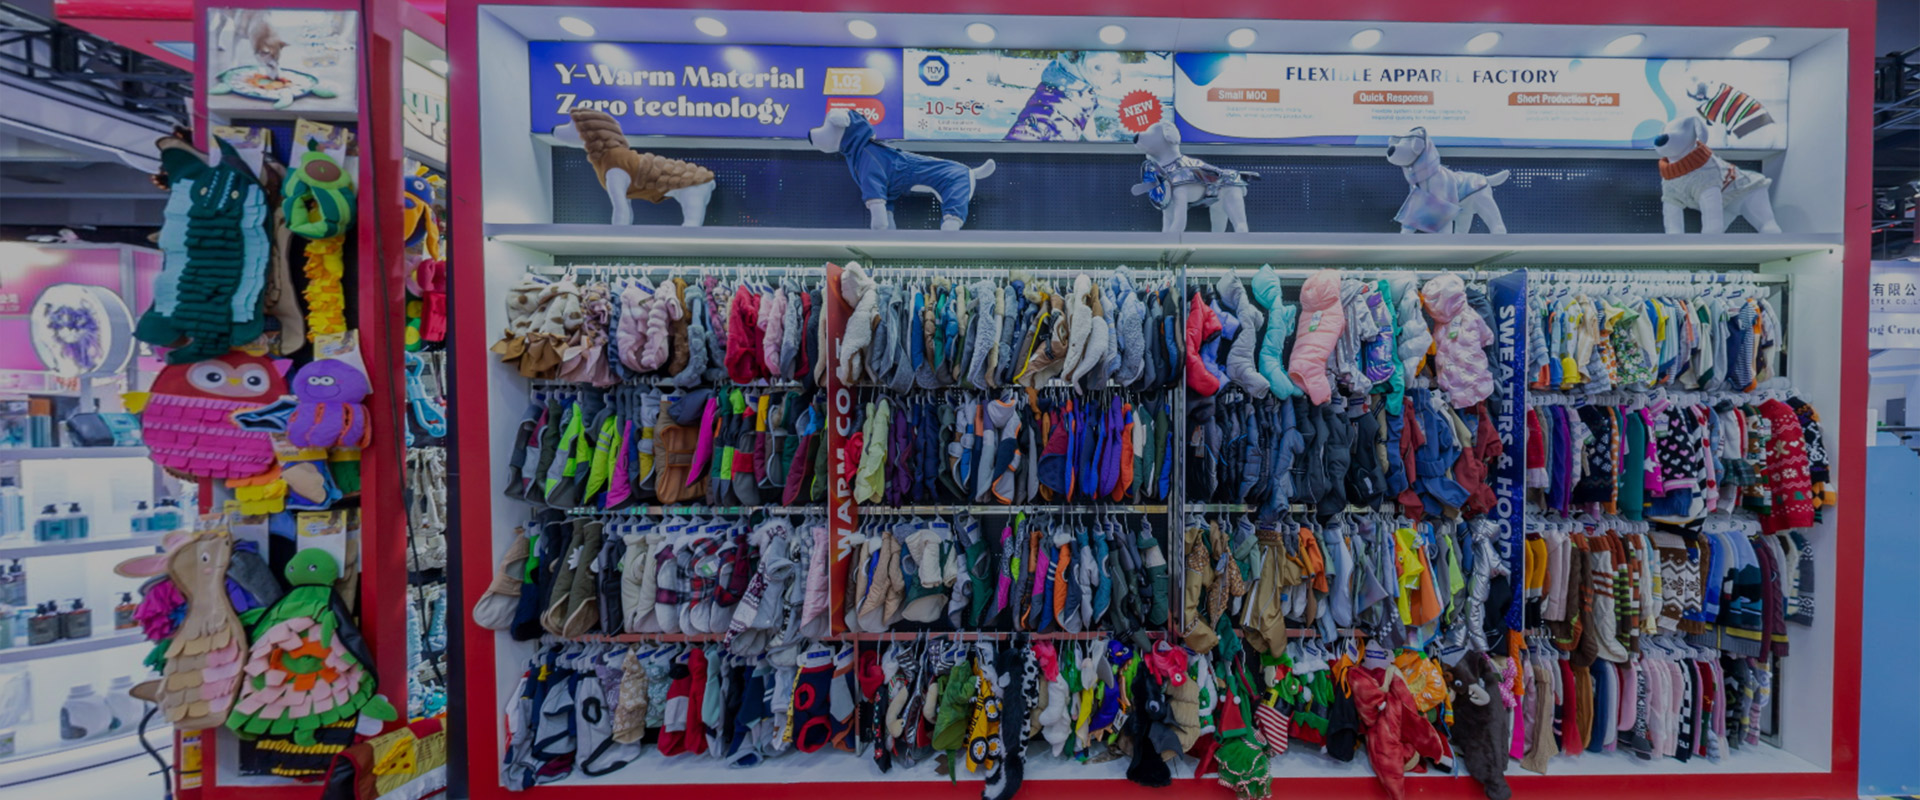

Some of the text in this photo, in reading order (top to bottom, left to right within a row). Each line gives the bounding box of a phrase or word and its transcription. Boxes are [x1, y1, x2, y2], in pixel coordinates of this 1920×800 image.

[554, 63, 805, 89] Y-Warm Material
[831, 75, 863, 88] 1.02
[1473, 69, 1559, 84] FACTORY
[1218, 90, 1267, 101] Small MOQ
[1360, 92, 1429, 104] Quick Response
[1517, 93, 1613, 106] Short Production Cycle
[633, 95, 790, 125] technology
[1123, 99, 1154, 118] NEW
[1498, 304, 1516, 446] SWEATERS
